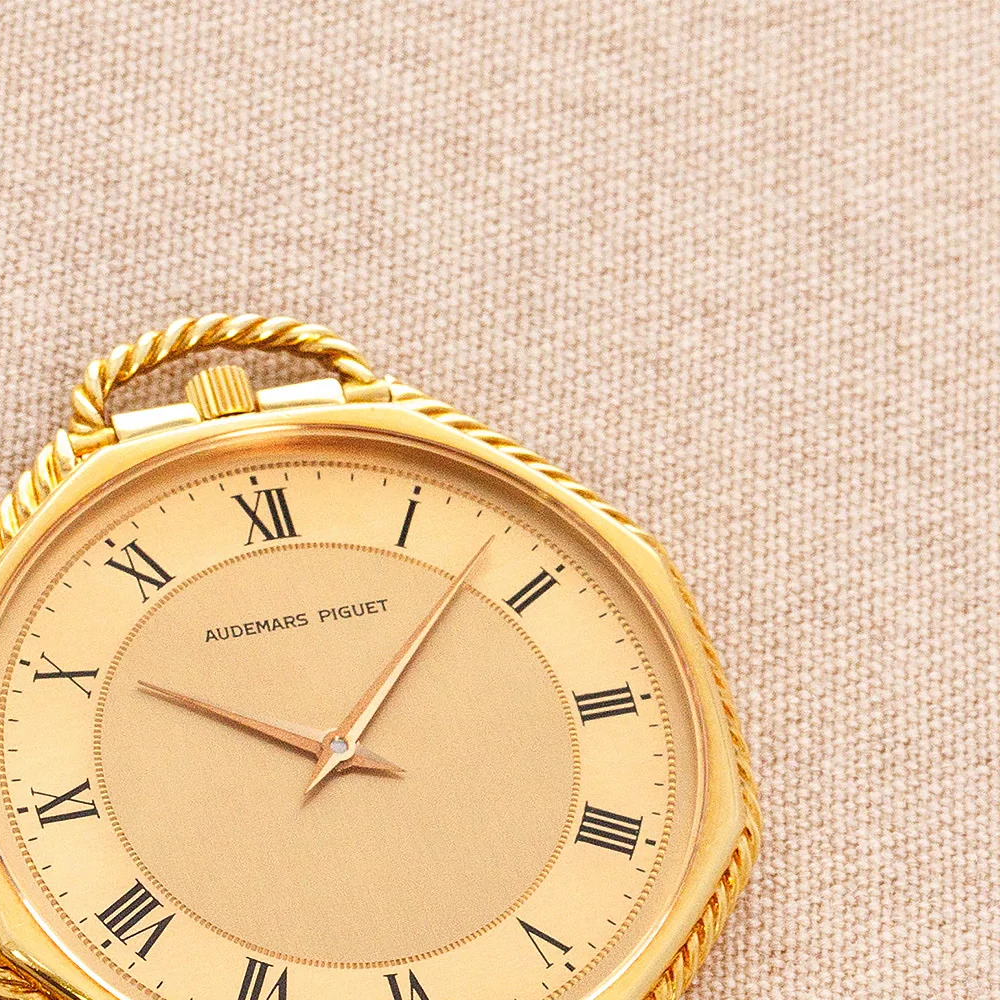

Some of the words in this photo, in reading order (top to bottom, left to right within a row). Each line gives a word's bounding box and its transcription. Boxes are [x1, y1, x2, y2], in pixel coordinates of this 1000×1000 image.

[232, 487, 301, 545] XII
[398, 499, 420, 548] I
[104, 540, 176, 602] XI
[503, 568, 562, 616] II
[205, 614, 309, 644] AUDEMARS
[318, 598, 389, 626] PIGUET
[33, 652, 99, 698] X
[573, 682, 639, 726] III
[31, 779, 99, 828] IX
[575, 802, 644, 859] IIII
[96, 880, 177, 961] VIII
[515, 918, 573, 968] V
